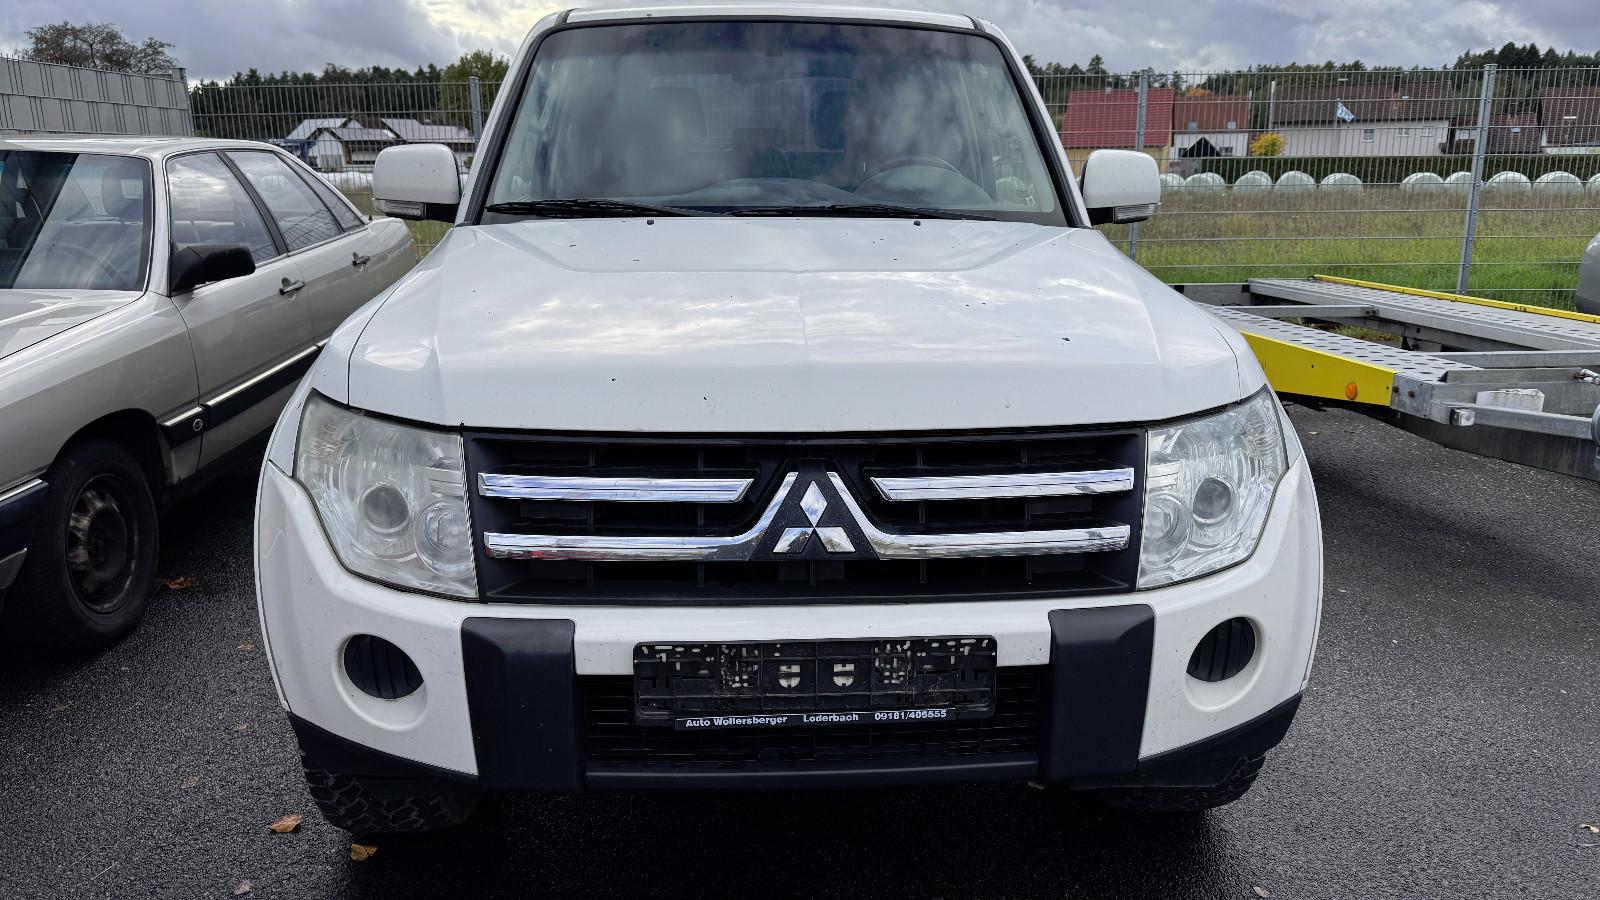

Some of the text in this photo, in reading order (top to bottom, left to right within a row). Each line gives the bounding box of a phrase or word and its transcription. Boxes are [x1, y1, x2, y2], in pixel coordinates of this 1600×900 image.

[686, 719, 711, 727] Auto
[713, 716, 788, 726] Wollersberger
[803, 713, 859, 723] Loderbach
